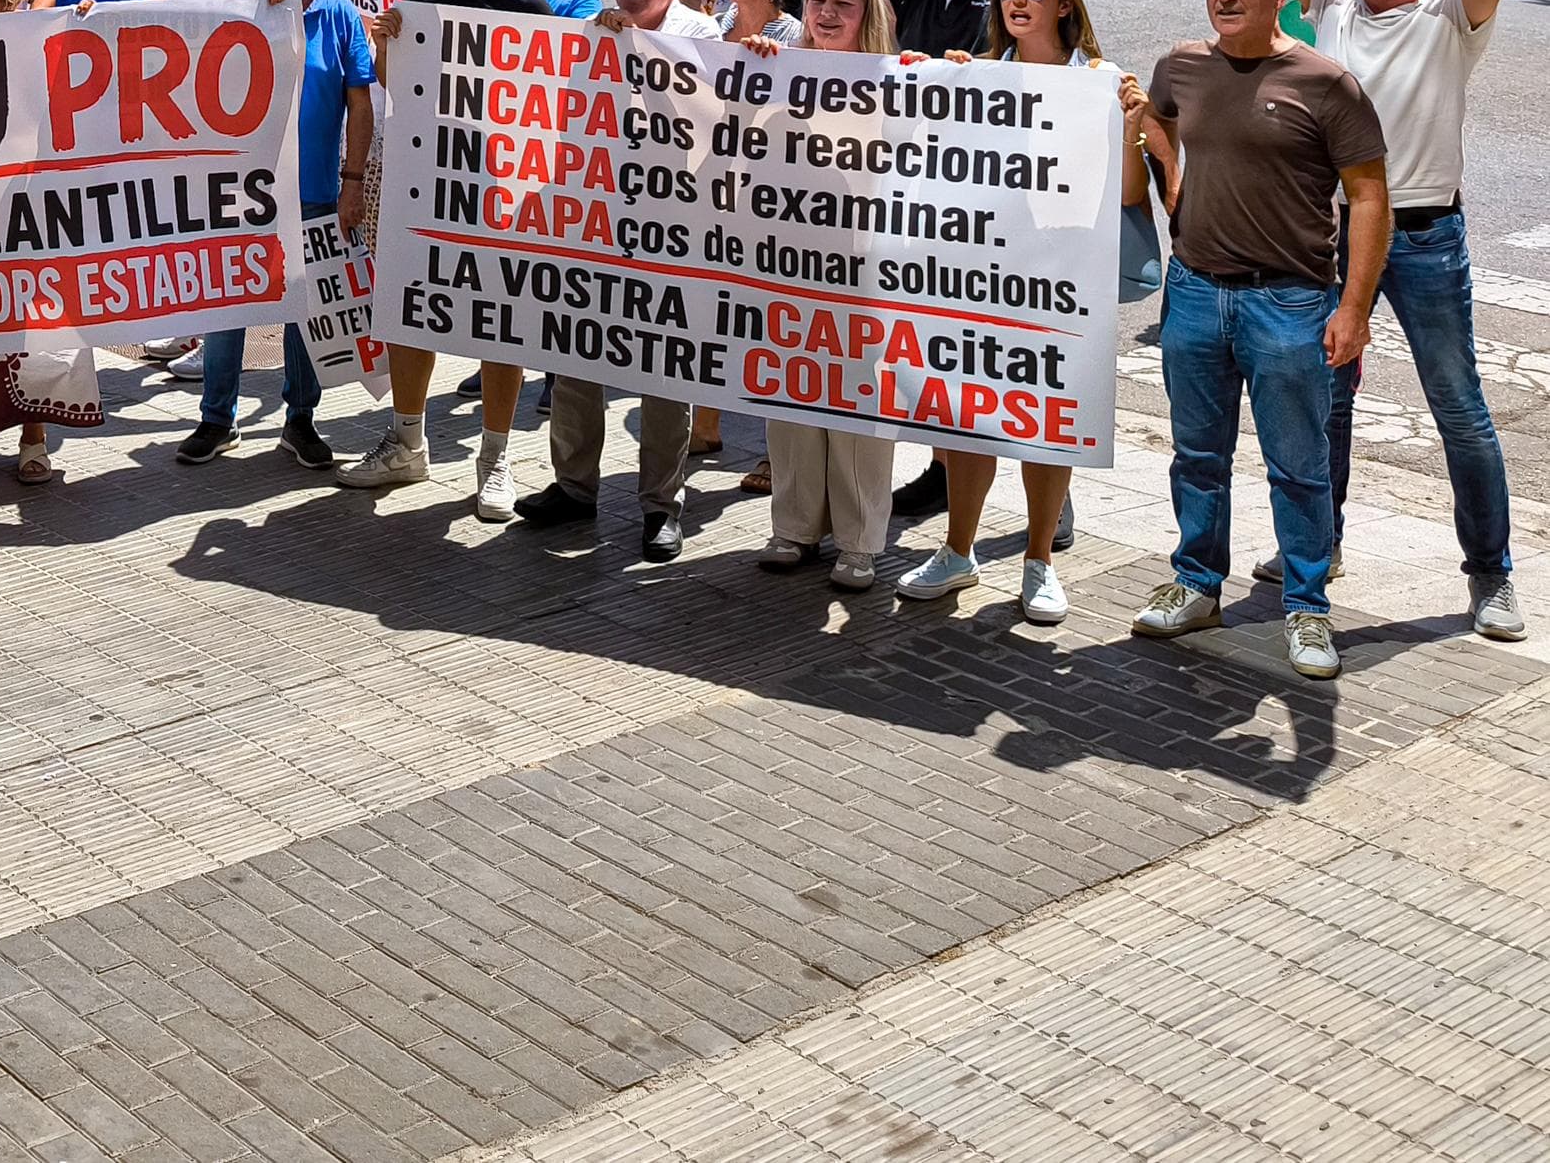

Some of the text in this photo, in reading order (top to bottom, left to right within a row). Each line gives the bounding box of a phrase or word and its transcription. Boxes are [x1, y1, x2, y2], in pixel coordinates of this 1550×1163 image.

[44, 19, 275, 152] PRO
[437, 72, 1071, 194] INCAPAços de reaccionar.
[441, 18, 1055, 132] INCAPAços de gestionar.
[435, 126, 698, 204] INCAPAços
[78, 242, 270, 318] ESTABLES
[433, 176, 1091, 317] INCAPAços de donar solucions.
[401, 283, 454, 335] ÉS
[470, 297, 524, 345] EL
[540, 310, 726, 387] NOSTRE
[427, 246, 1067, 391] LA VOSTRA inCAPAcitat
